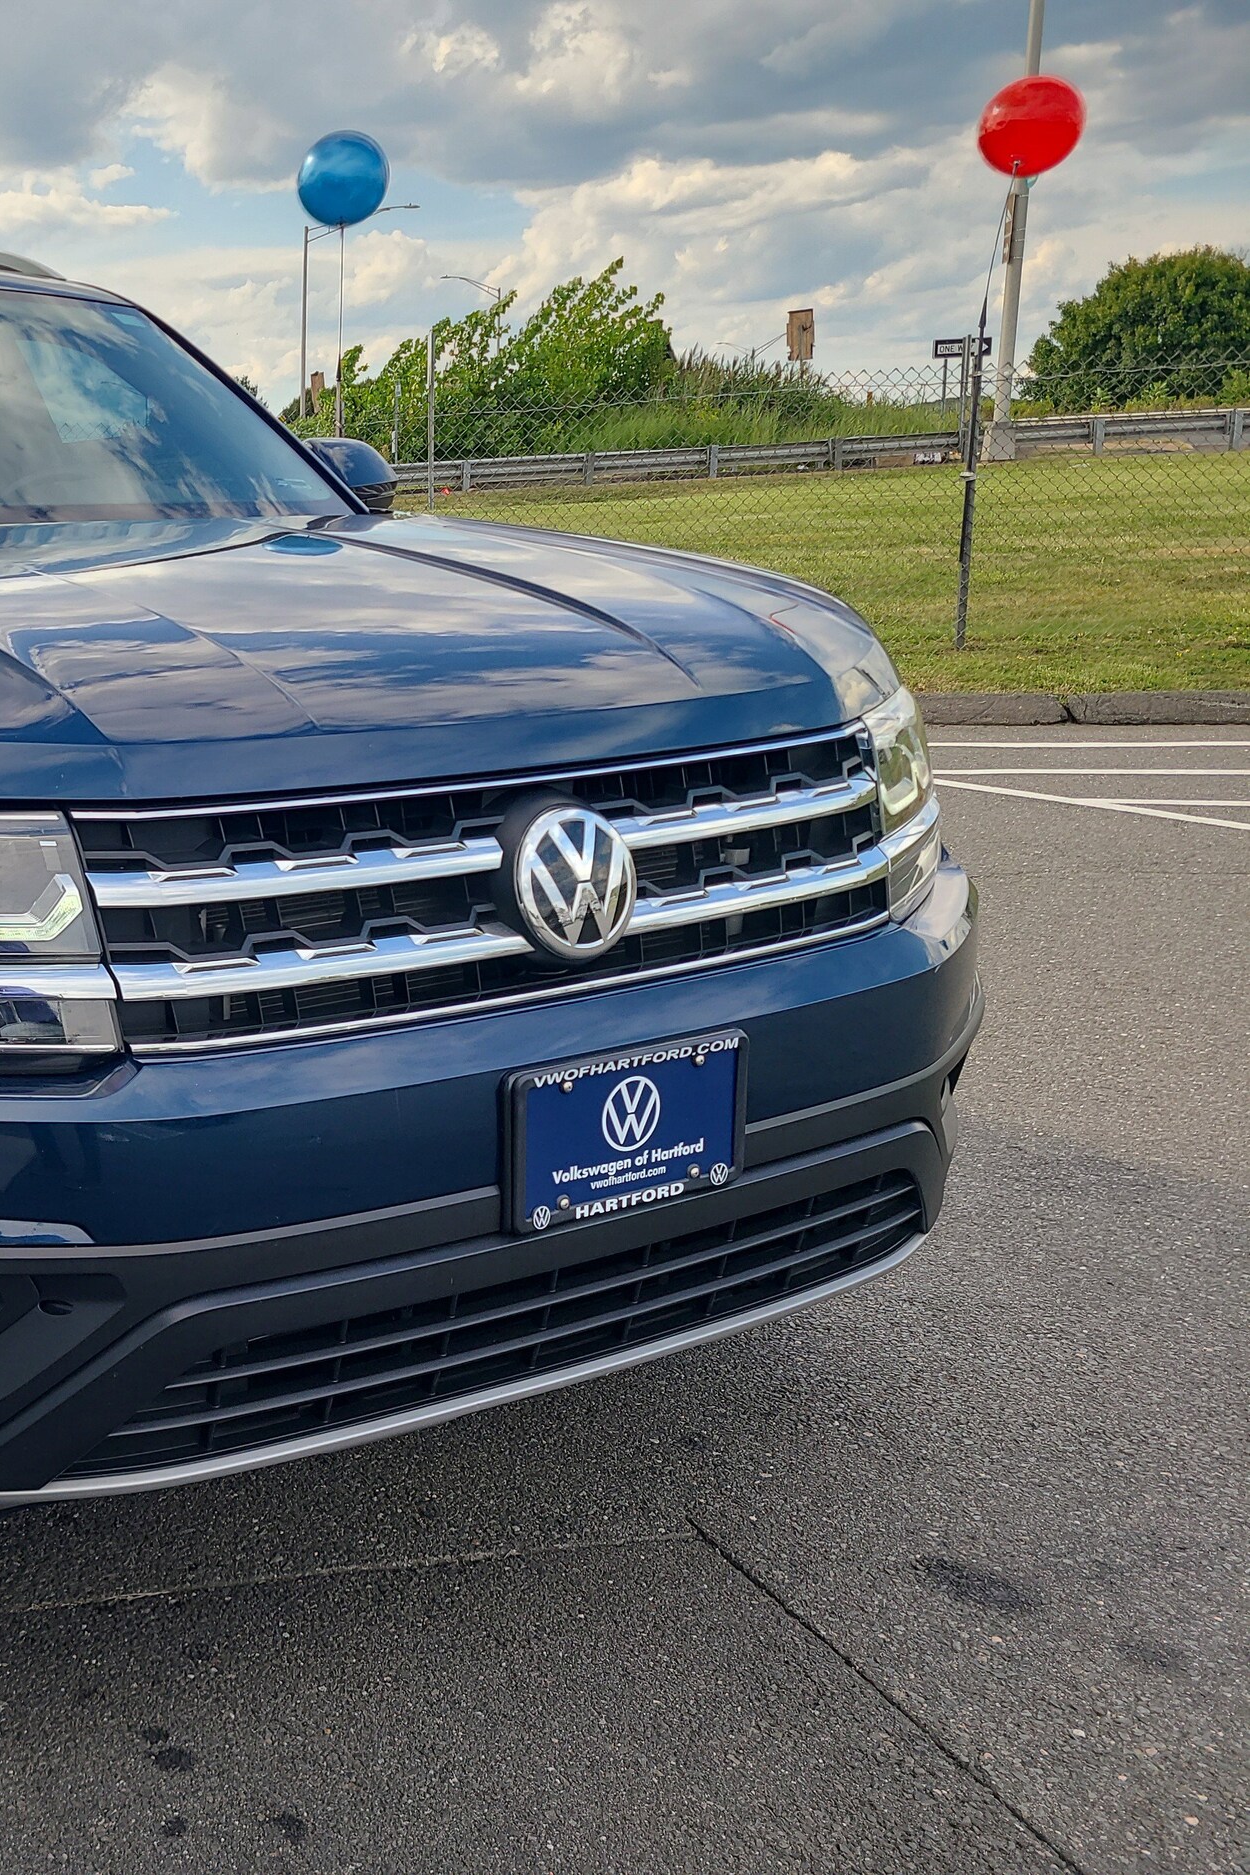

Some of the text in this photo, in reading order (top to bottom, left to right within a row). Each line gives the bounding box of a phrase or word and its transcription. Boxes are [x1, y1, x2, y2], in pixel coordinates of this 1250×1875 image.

[939, 345, 955, 353] ONE
[534, 1037, 740, 1088] VWOFHARTFORD.COM
[602, 1076, 661, 1152] VW
[552, 1138, 704, 1185] Volkswagen of Hartford
[590, 1165, 667, 1190] vwofhartford.com
[575, 1182, 685, 1219] HARTFORD
